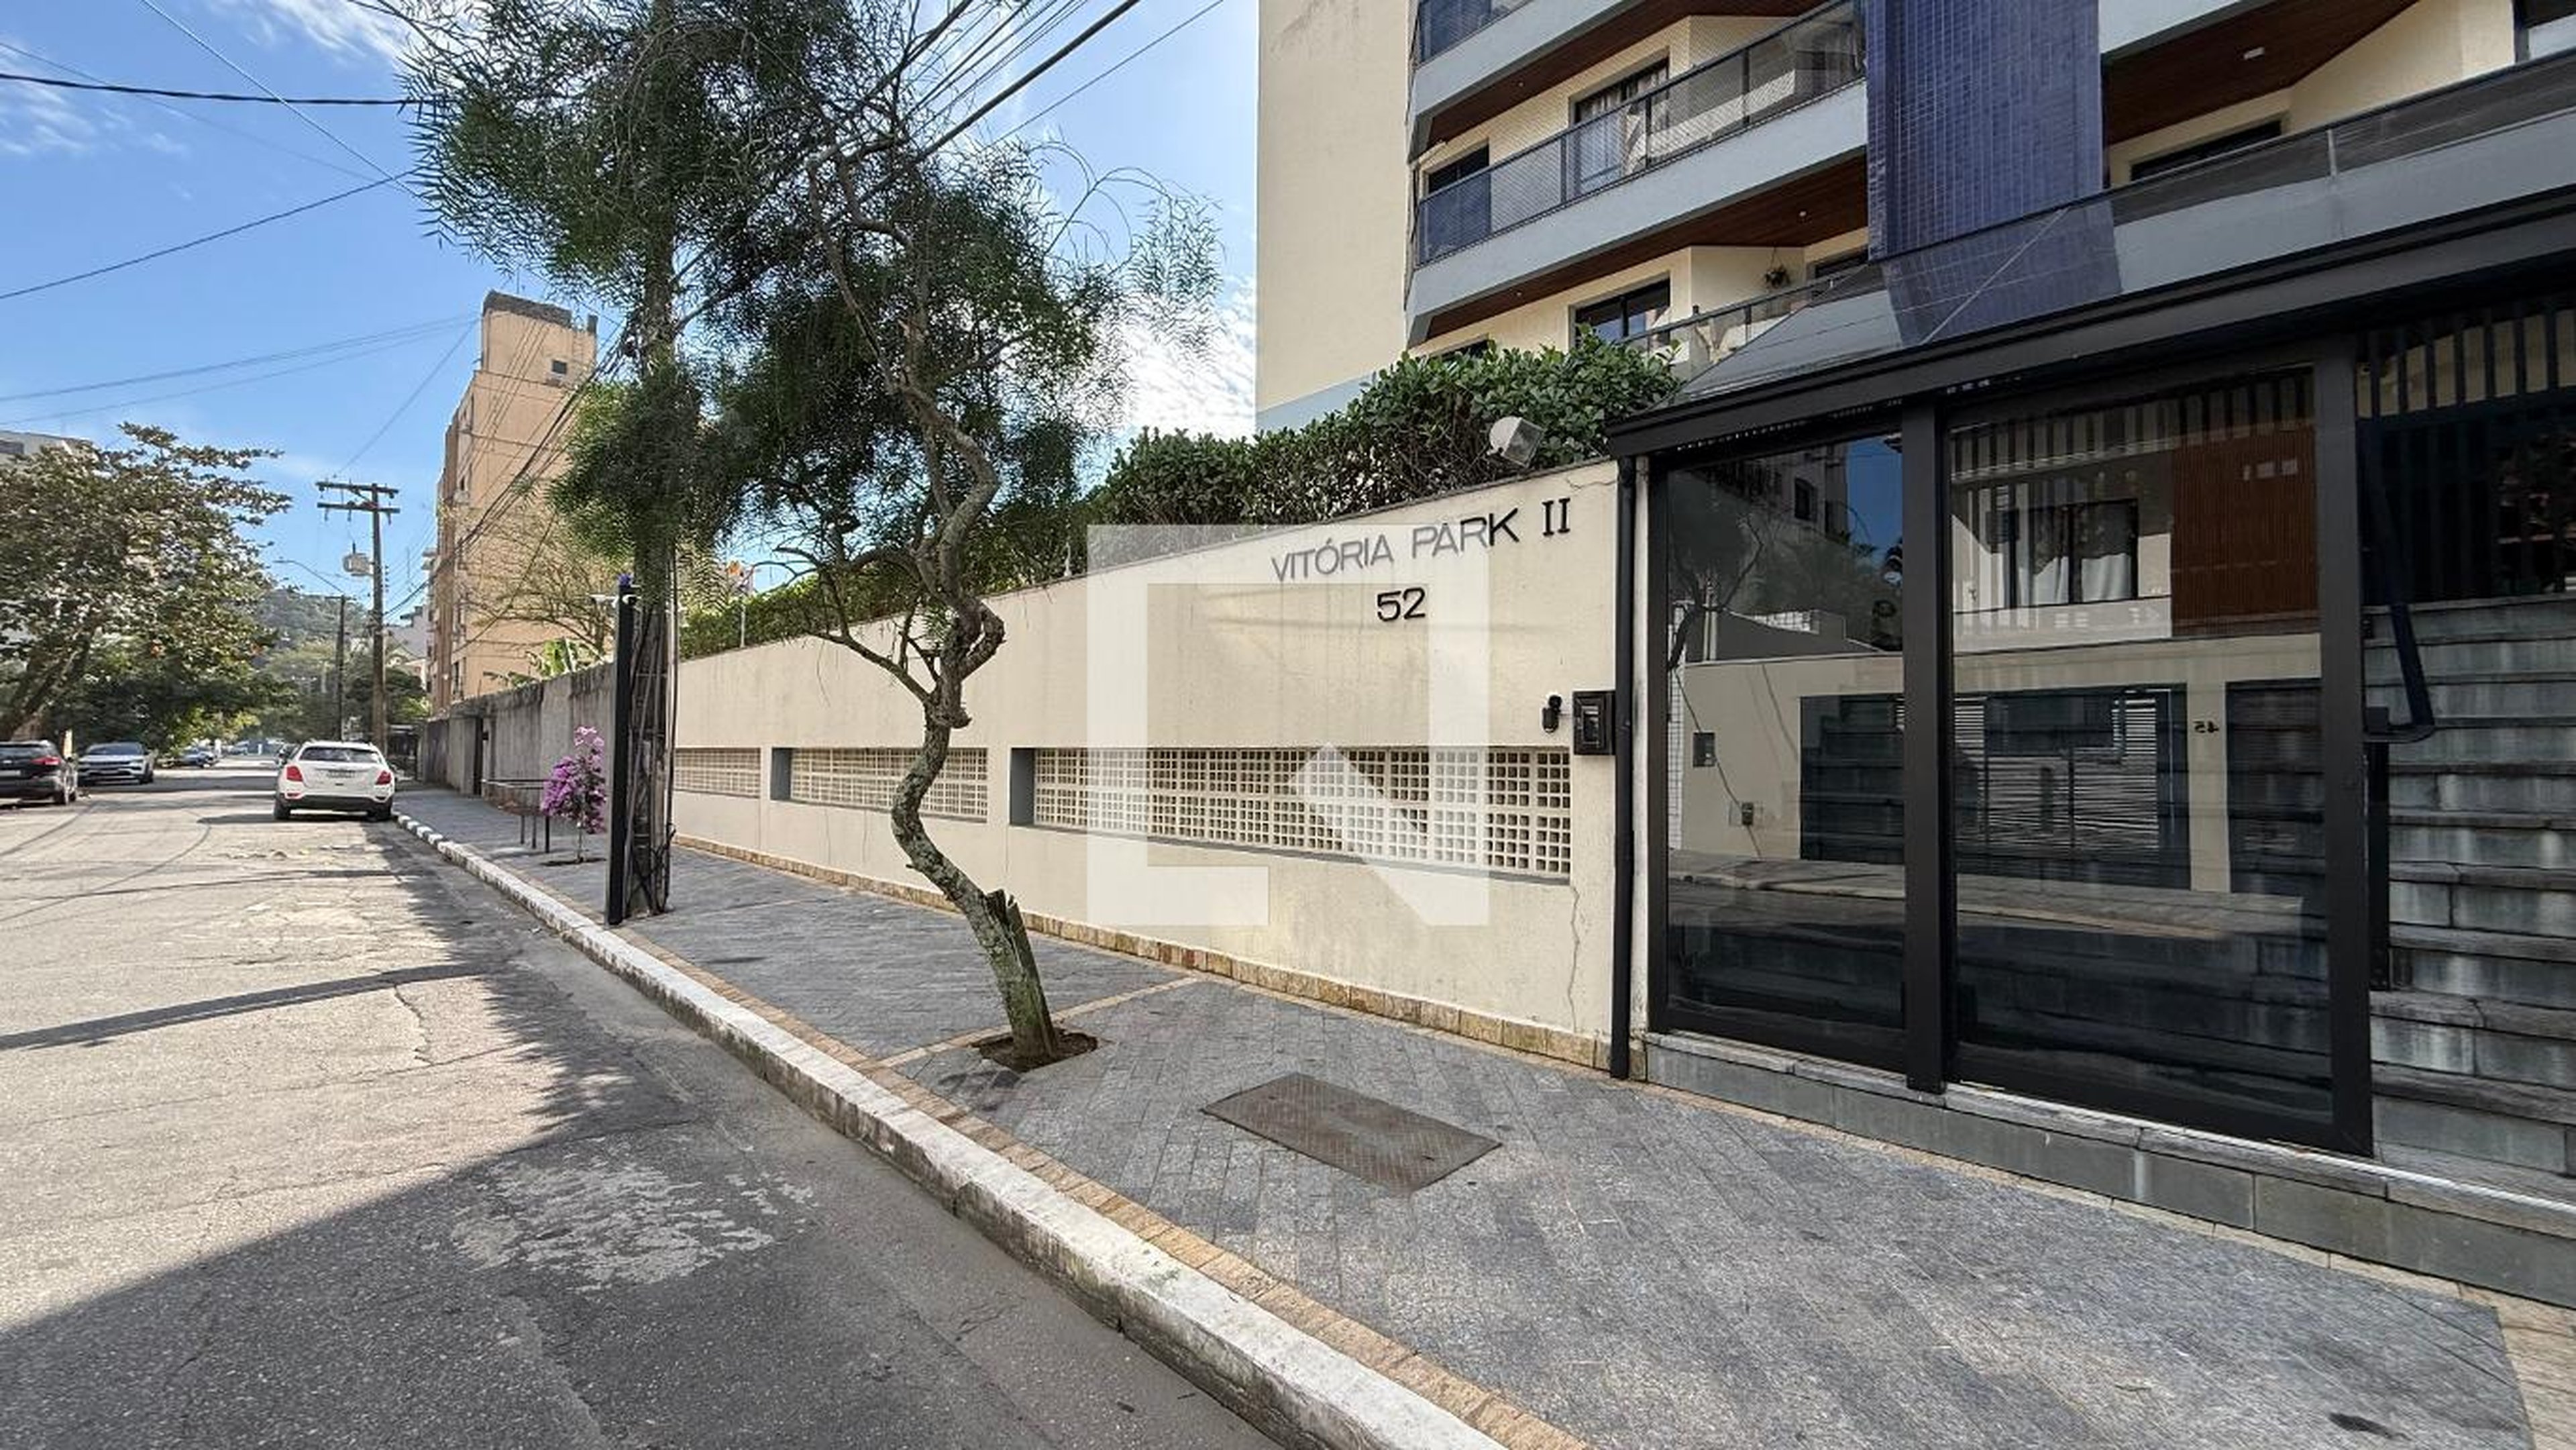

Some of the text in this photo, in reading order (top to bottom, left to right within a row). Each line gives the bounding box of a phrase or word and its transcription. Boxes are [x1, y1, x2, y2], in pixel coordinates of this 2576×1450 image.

[1271, 497, 1571, 582] VITÓRIA PARK II
[1376, 586, 1426, 622] 52
